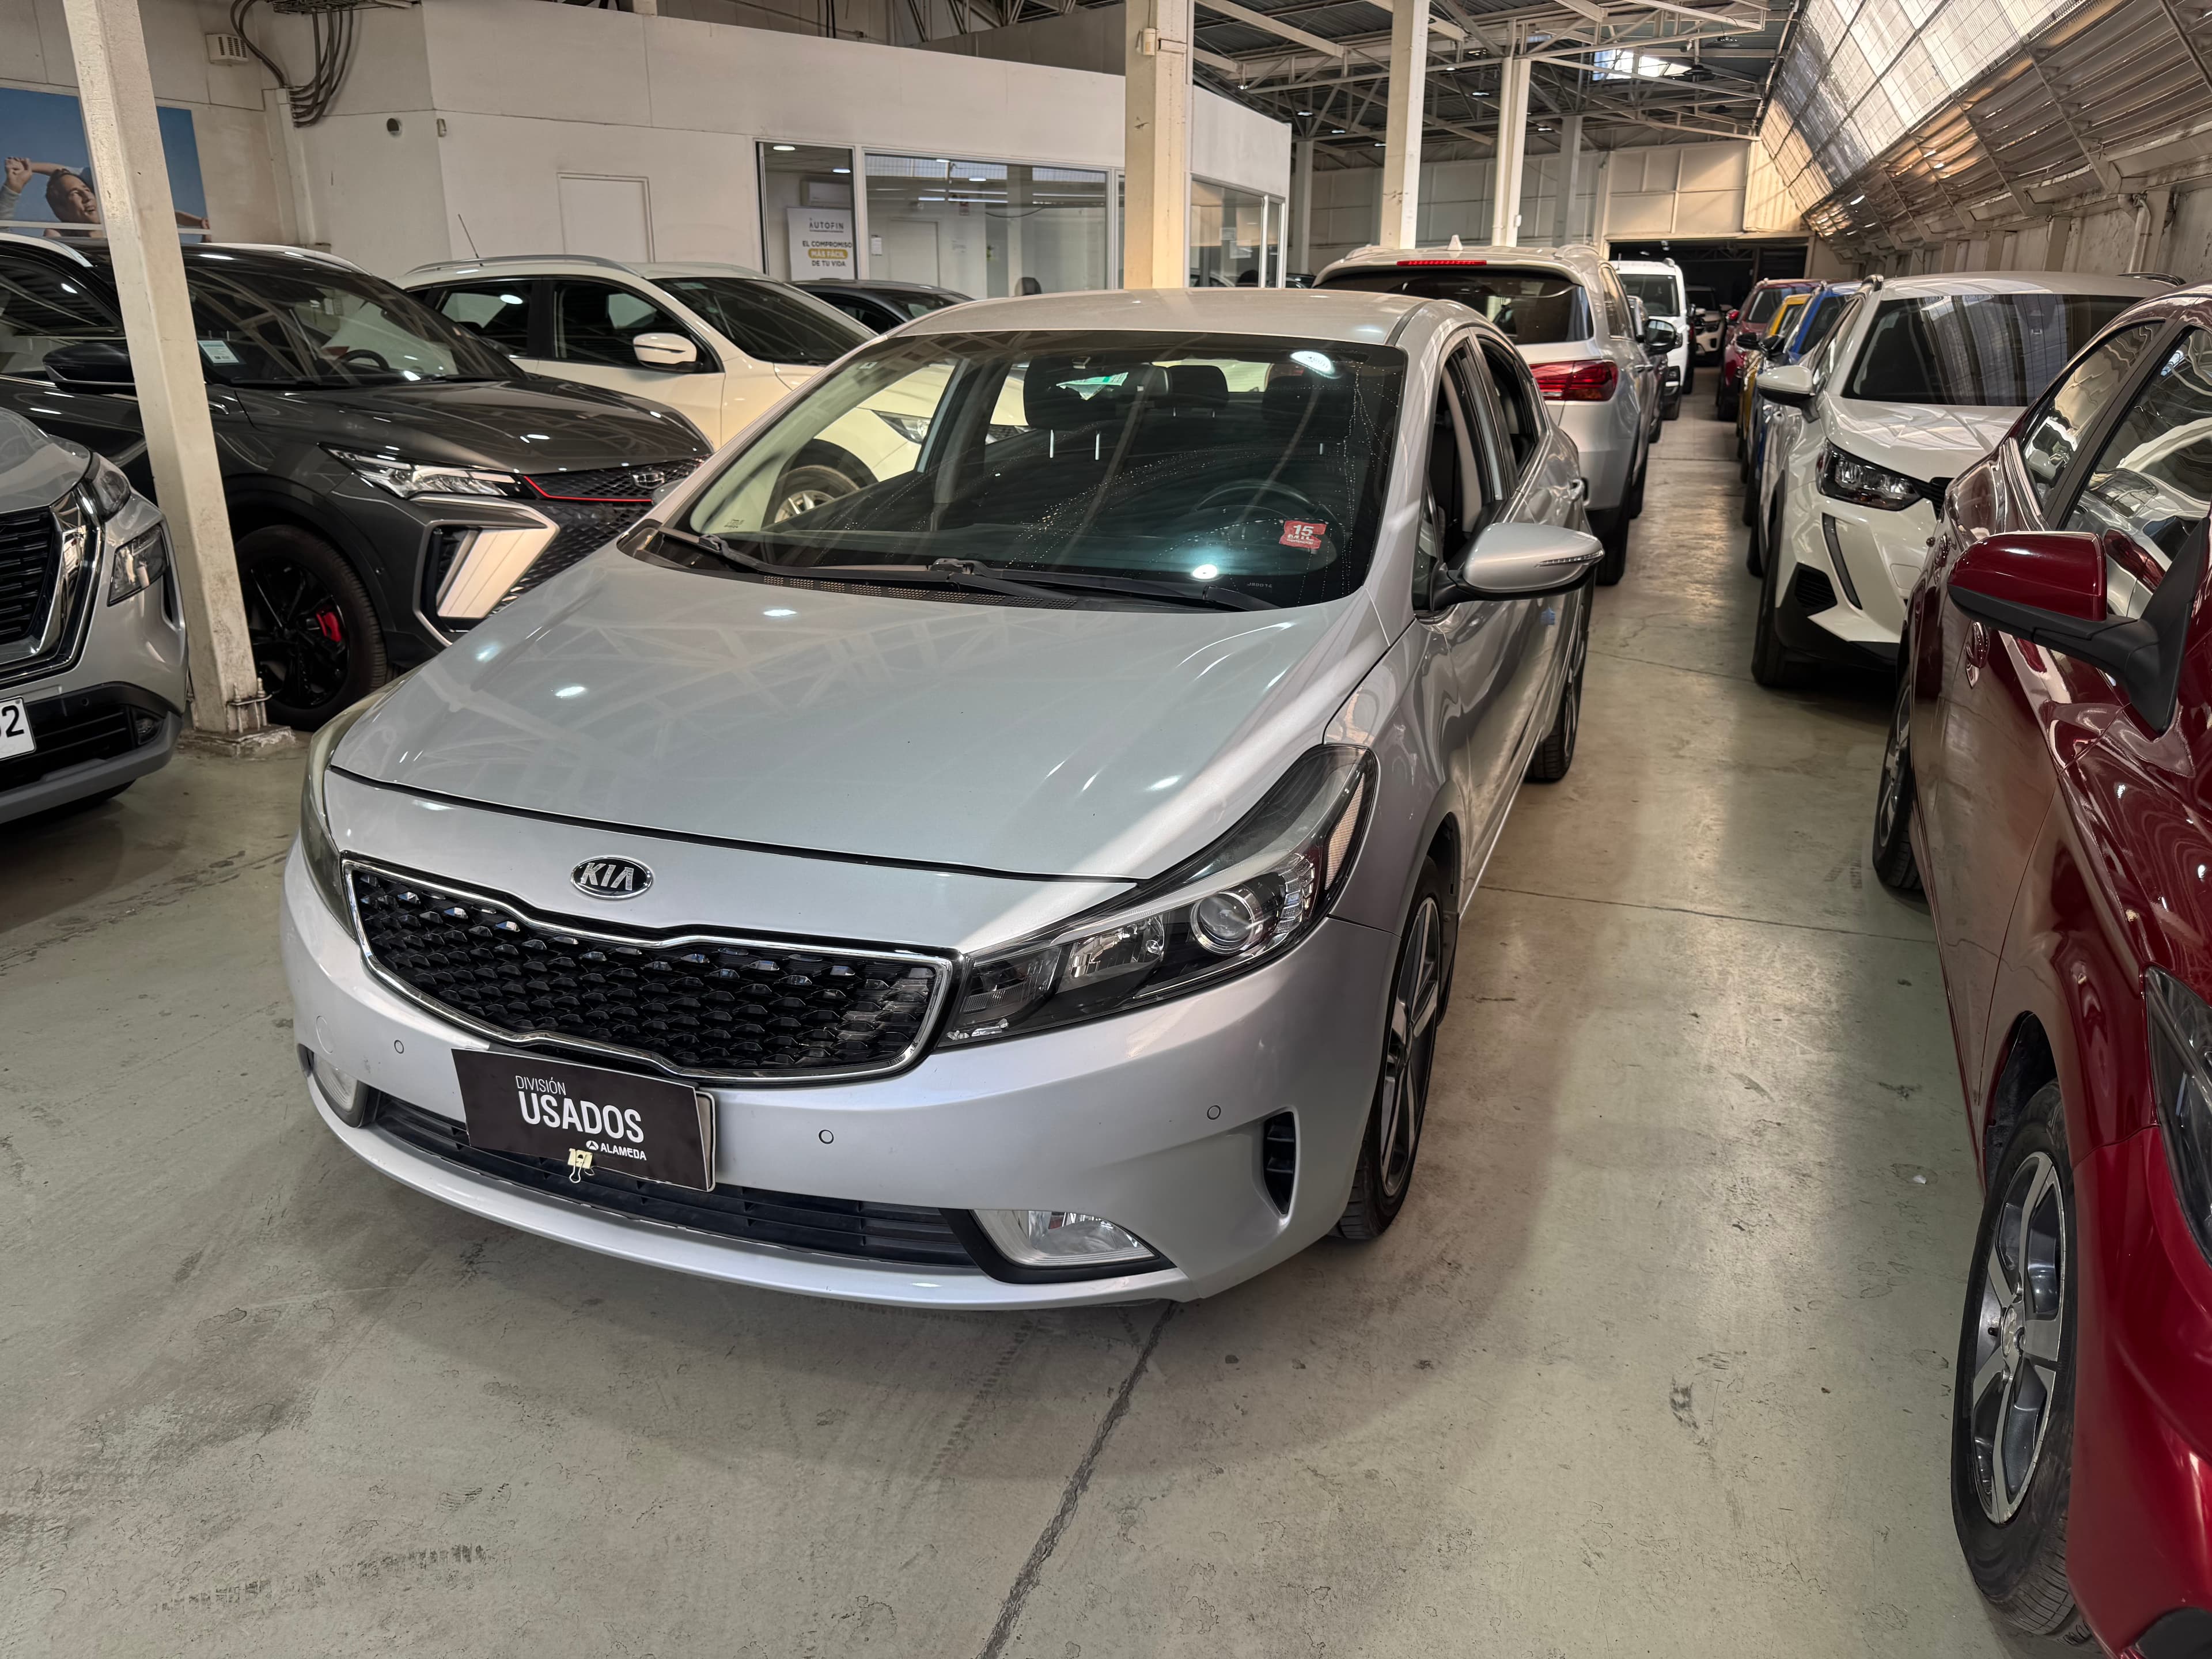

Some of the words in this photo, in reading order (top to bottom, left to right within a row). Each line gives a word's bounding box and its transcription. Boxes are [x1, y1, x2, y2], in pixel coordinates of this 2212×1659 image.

[809, 222, 844, 230] AUTOFIN
[1293, 525, 1314, 536] 15
[0, 705, 24, 738] 2
[580, 862, 634, 891] KIA
[516, 1075, 566, 1096] DIVISIÓN
[518, 1090, 645, 1143] USADOS
[600, 1142, 647, 1161] ALAMEDA
